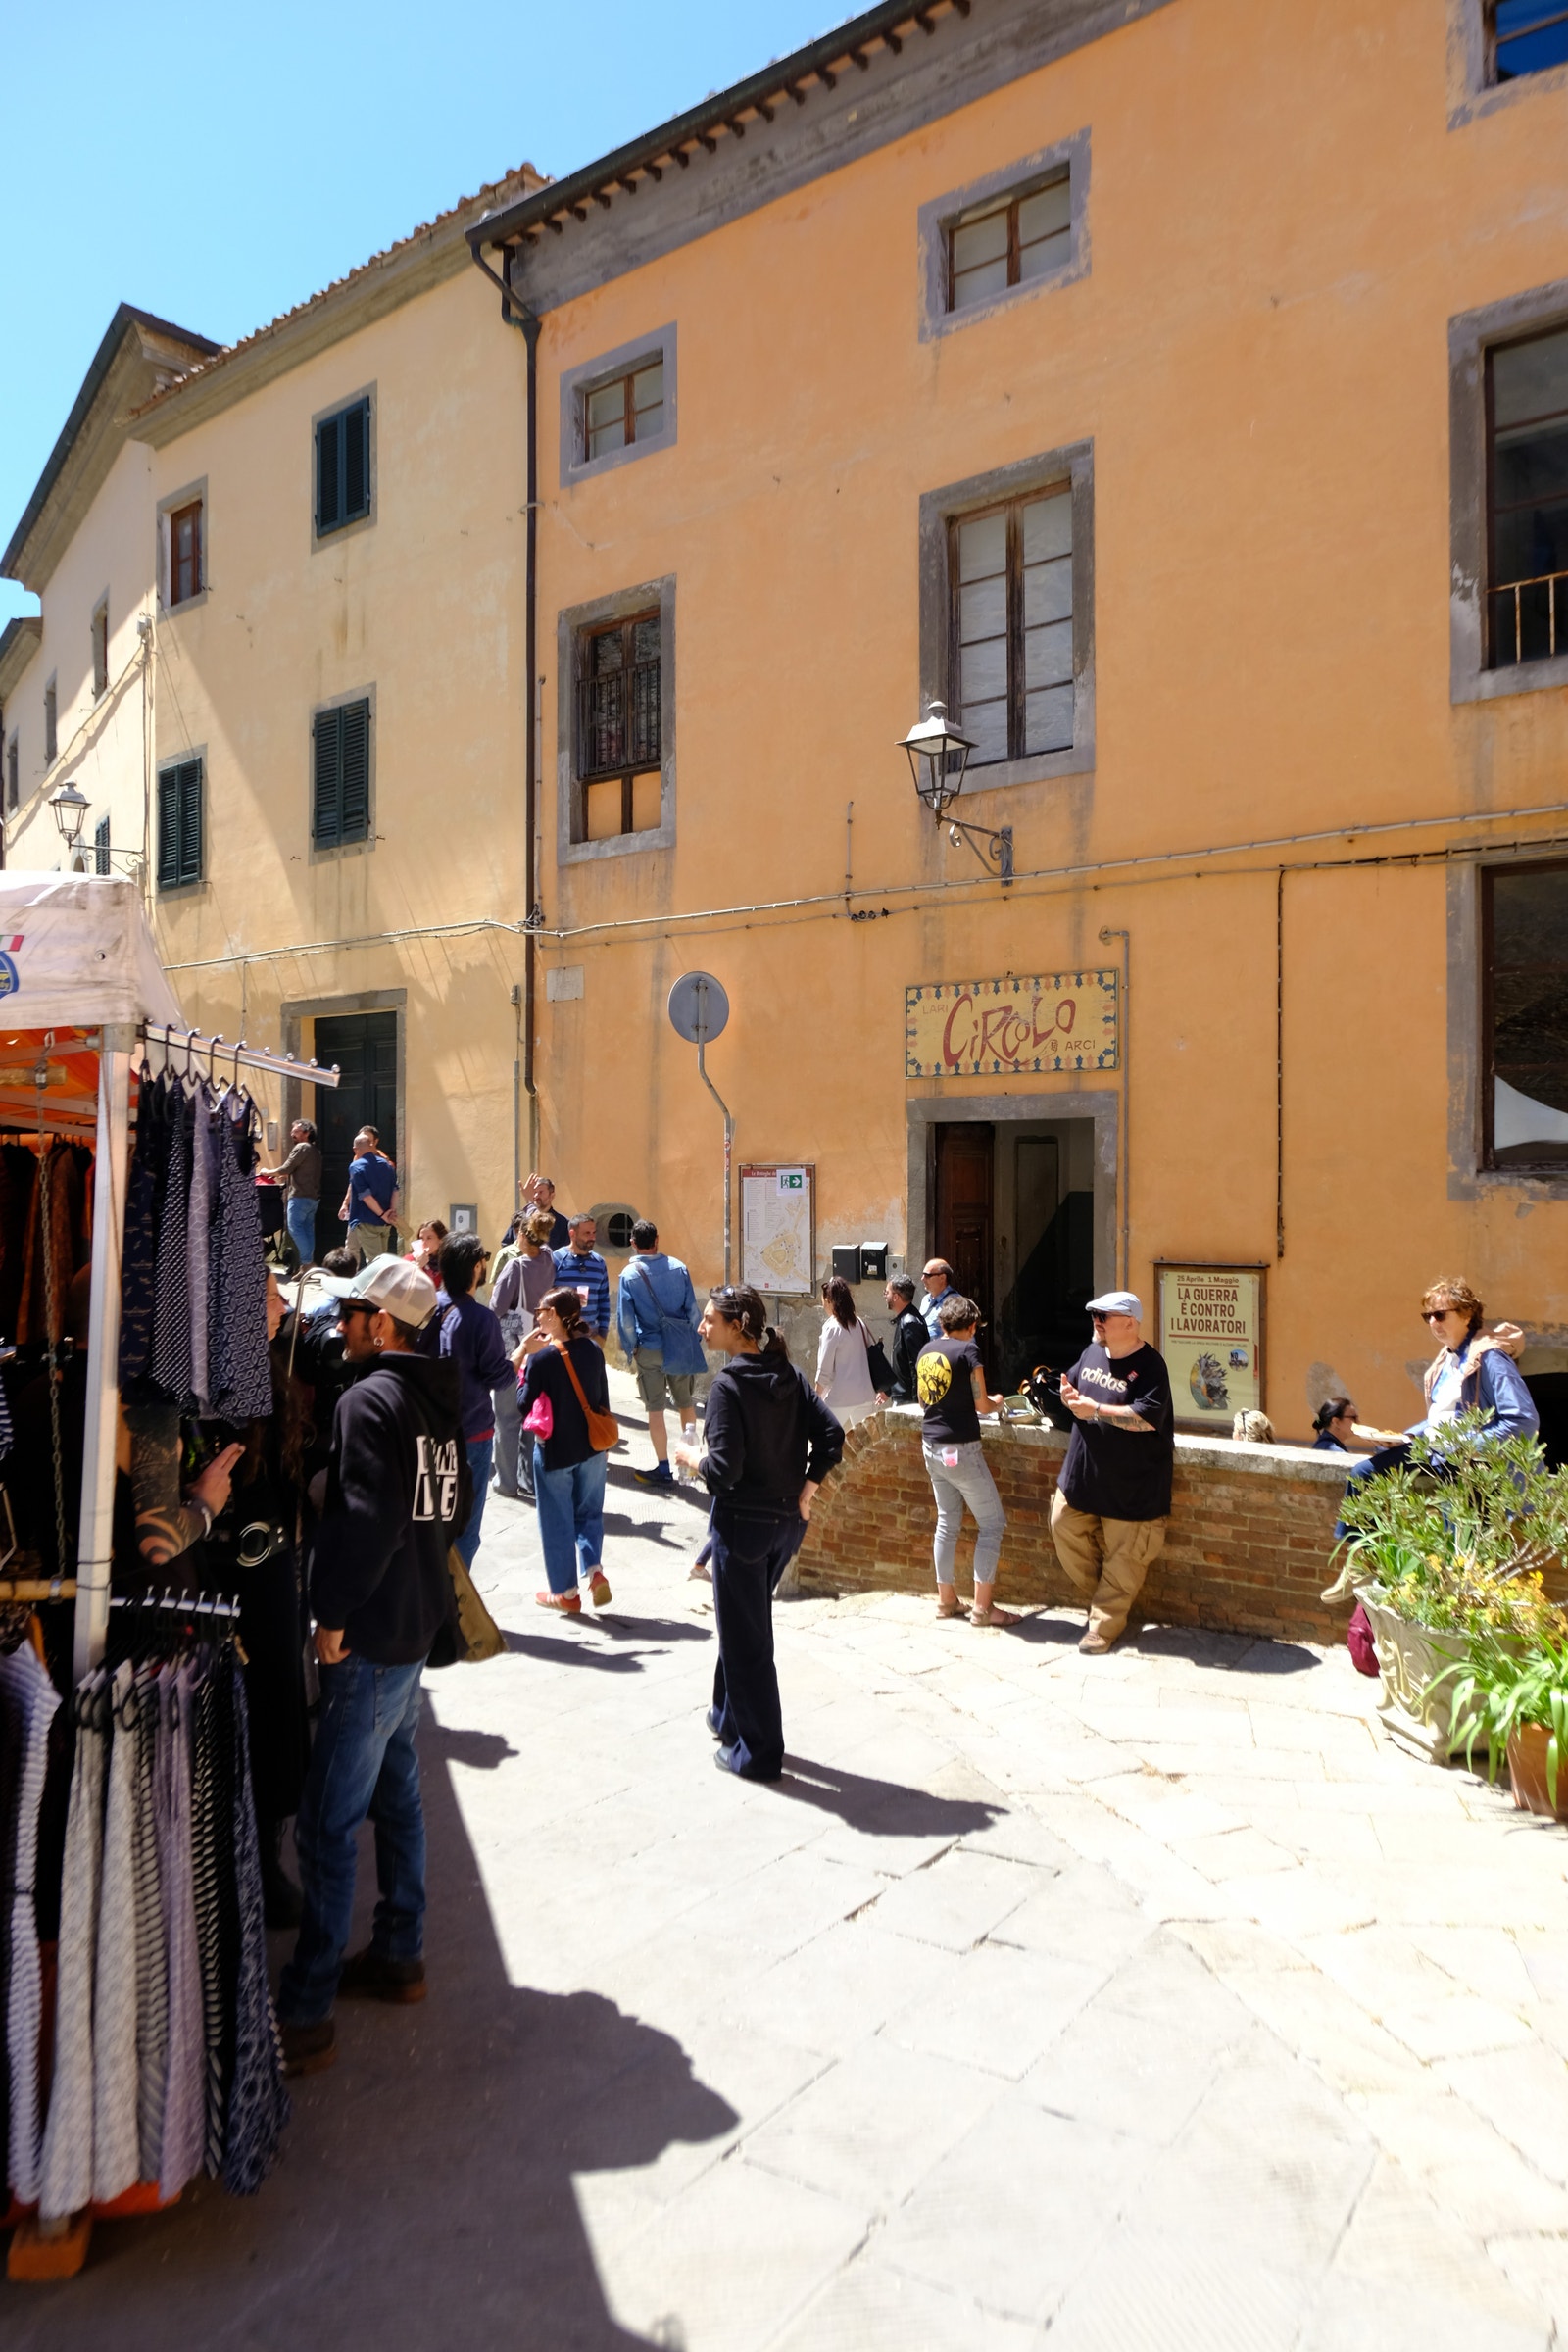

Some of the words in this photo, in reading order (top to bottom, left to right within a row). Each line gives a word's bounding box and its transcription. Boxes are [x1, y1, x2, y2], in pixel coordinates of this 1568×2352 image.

[922, 1004, 949, 1015] LARI
[1064, 1039, 1096, 1051] ARCI
[1178, 1288, 1191, 1300] LA
[1193, 1288, 1239, 1302] GUERRA
[1190, 1302, 1235, 1318] CONTRO
[1170, 1317, 1174, 1331] I
[1177, 1318, 1246, 1334] LAVORATORI
[1080, 1366, 1127, 1393] adidas
